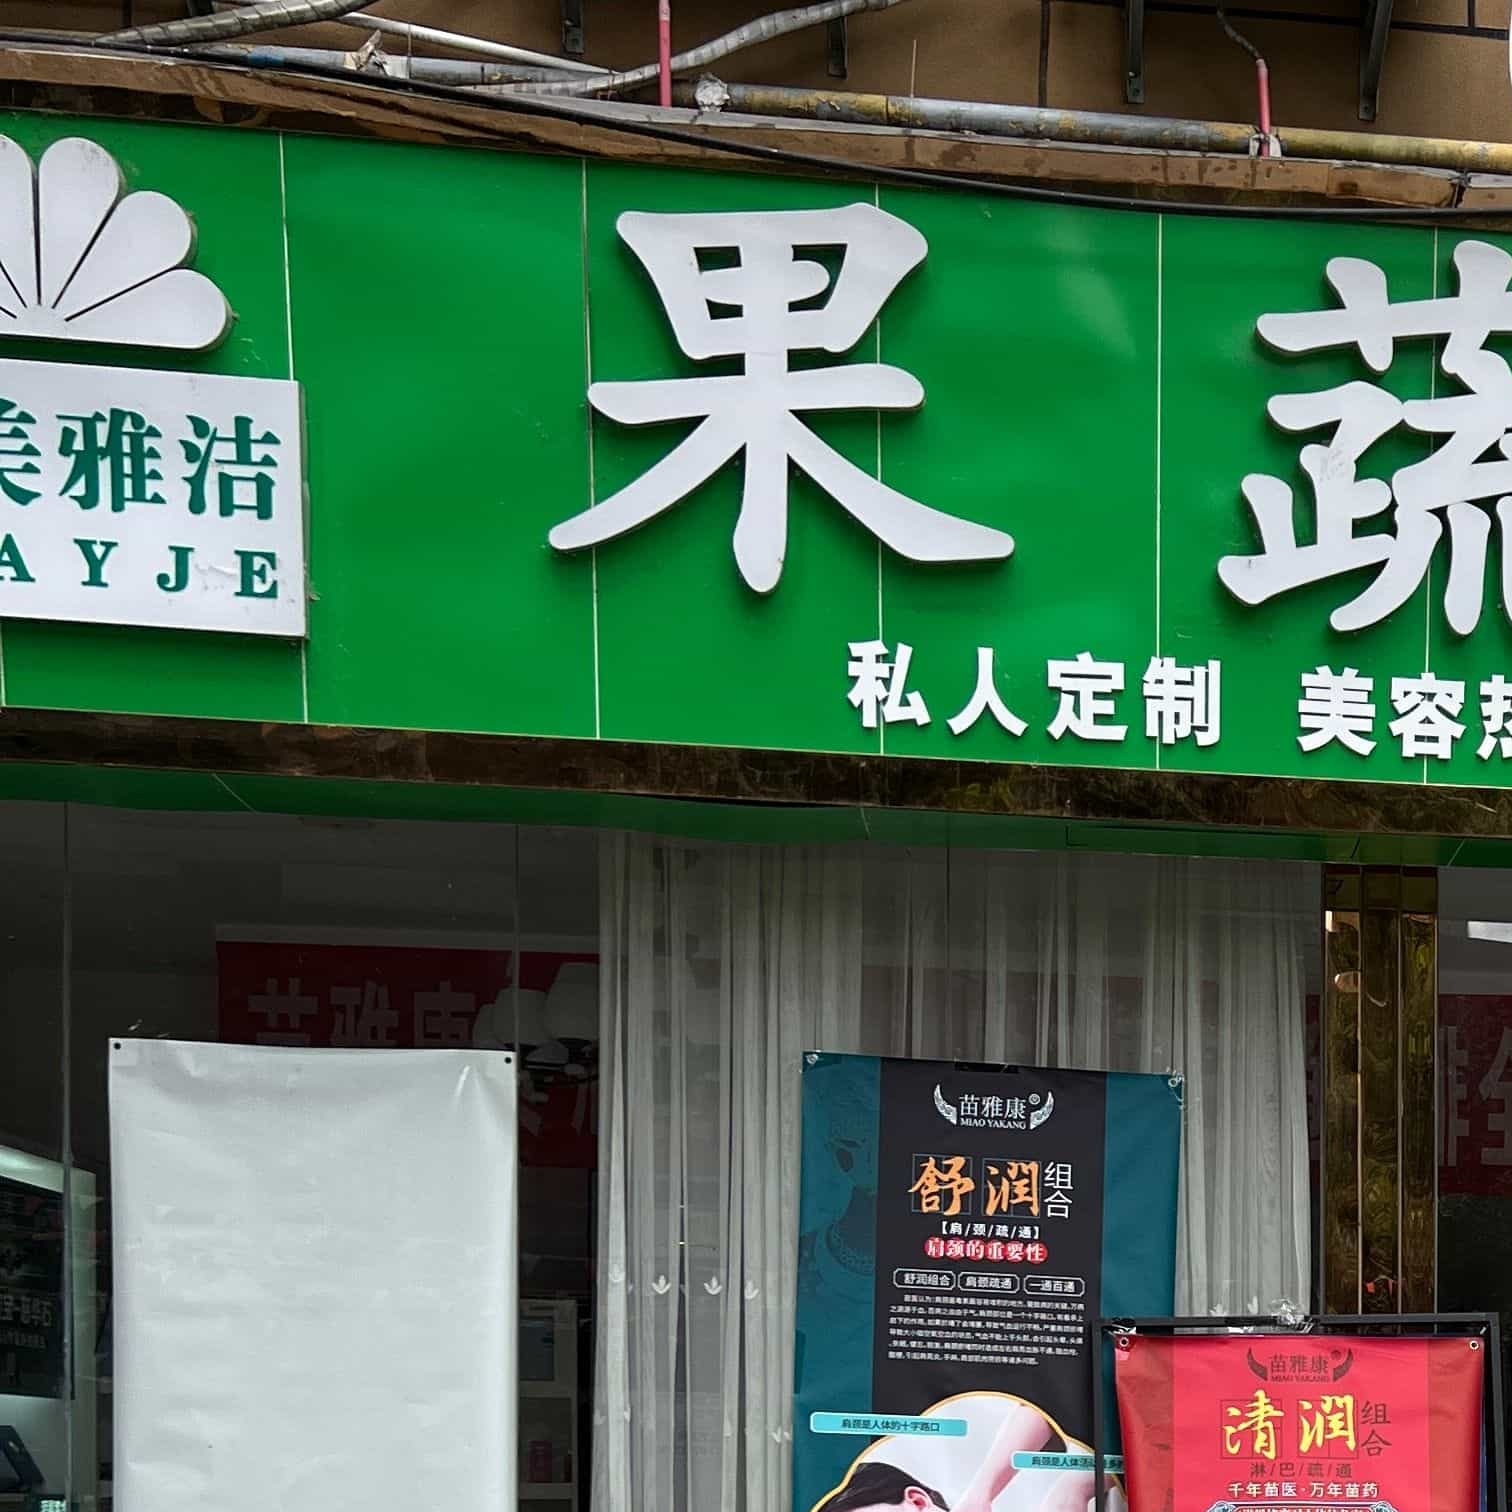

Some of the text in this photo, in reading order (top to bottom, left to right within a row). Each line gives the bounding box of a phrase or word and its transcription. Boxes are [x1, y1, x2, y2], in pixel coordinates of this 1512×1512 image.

[847, 639, 1223, 747] 私人定制
[958, 1093, 1026, 1120] 苗雅康
[960, 1117, 1026, 1130] MIAO YAKANG
[1044, 1162, 1074, 1218] 组合
[926, 1237, 1046, 1262] 肩颈的重要性
[1361, 1401, 1392, 1458] 组合
